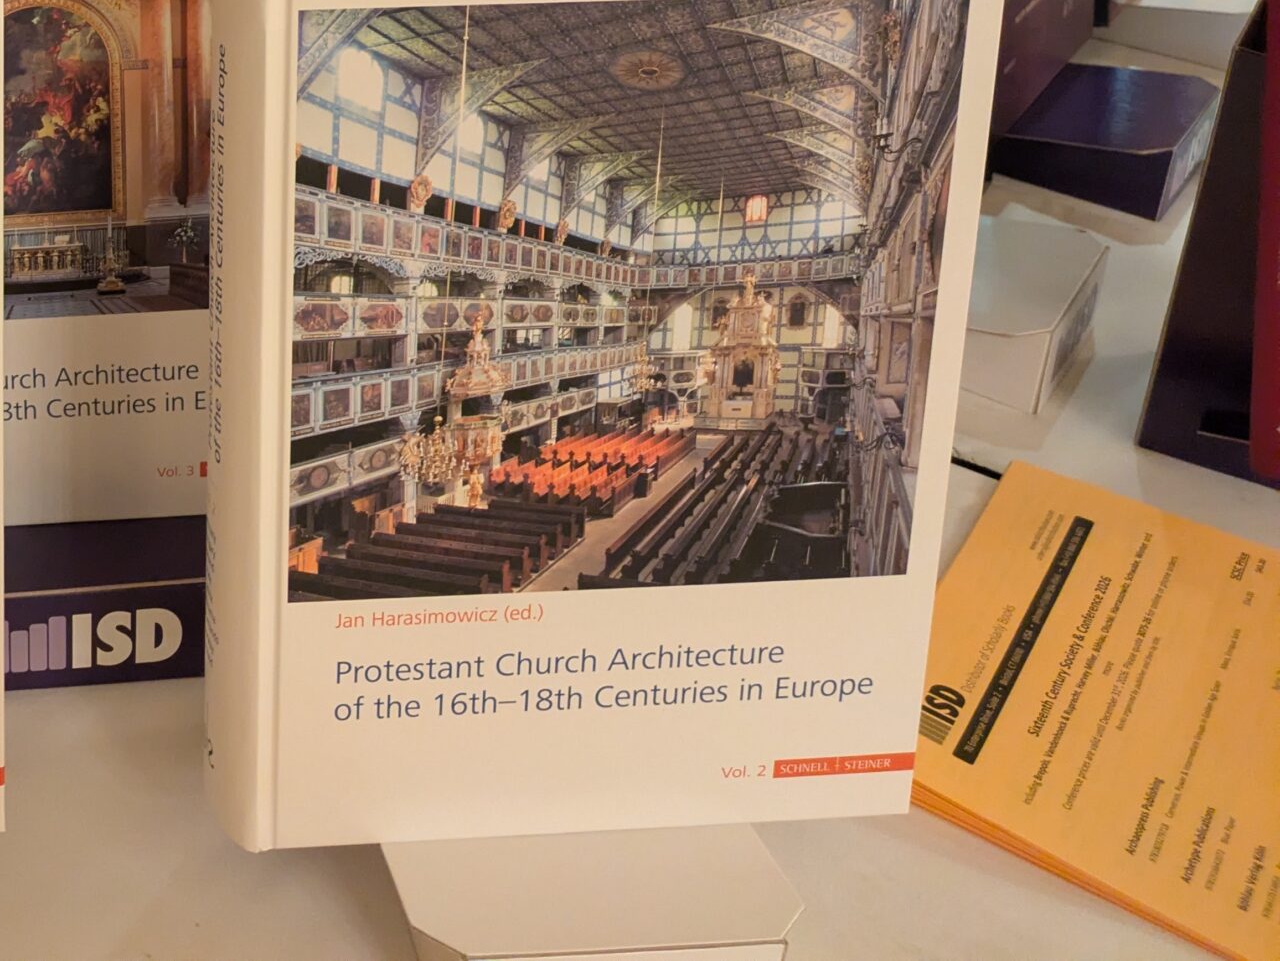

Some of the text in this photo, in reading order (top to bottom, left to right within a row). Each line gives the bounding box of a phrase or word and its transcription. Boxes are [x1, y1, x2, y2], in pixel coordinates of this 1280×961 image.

[55, 363, 199, 387] Architecture
[47, 392, 184, 418] Centuries in
[157, 465, 194, 477] Vol. 3
[335, 603, 544, 629] Jan Harasimowicz (ed.)
[72, 607, 183, 669] ISD
[335, 643, 785, 685] Protestant Church Architecture
[1026, 574, 1112, 738] Sixteenth Century Society & Conference 2026
[334, 694, 366, 722] of
[374, 692, 421, 720] the
[594, 680, 728, 709] Centuries
[739, 676, 763, 702] in
[775, 674, 874, 706] Europe
[922, 684, 966, 726] ISD
[721, 757, 891, 780] Vol. 2 SCHNELL STEINER
